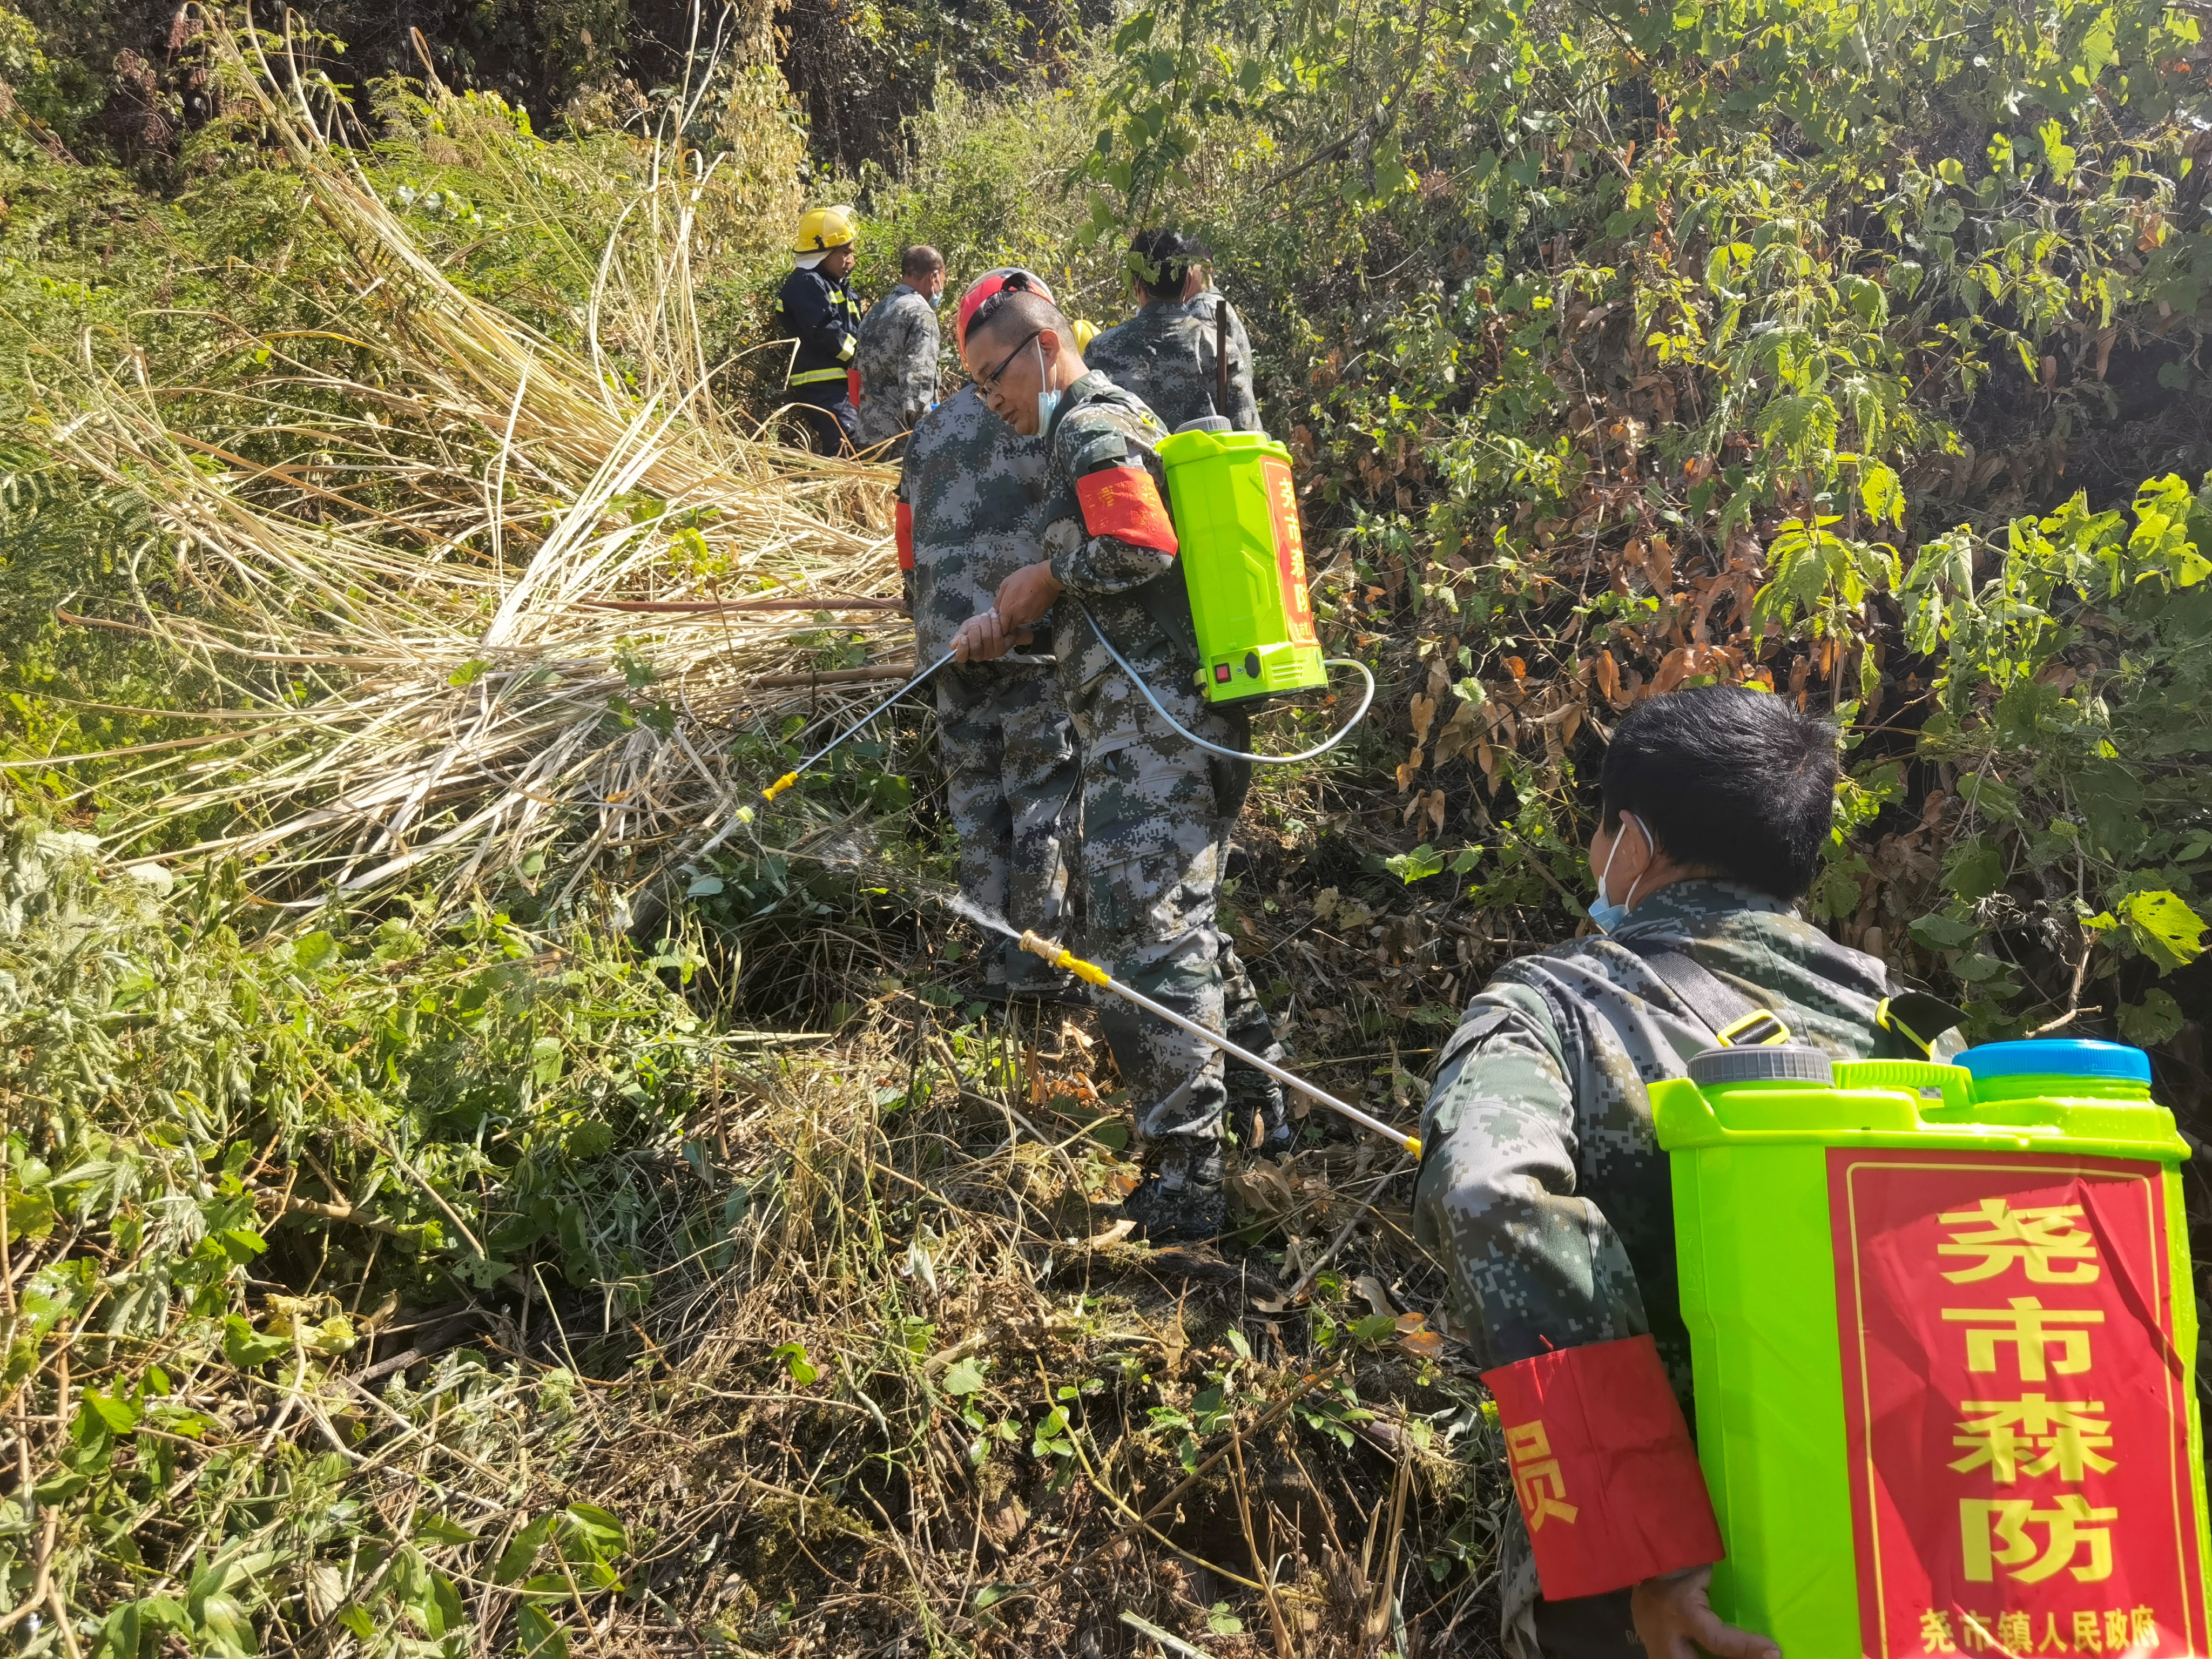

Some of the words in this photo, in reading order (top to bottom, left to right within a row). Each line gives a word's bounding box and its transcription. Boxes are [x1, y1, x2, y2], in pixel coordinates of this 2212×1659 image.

[1937, 1198, 2117, 1584] 尧市森防
[1506, 1419, 1579, 1533] 员
[1919, 1604, 2160, 1654] 尧市镇人民政府
